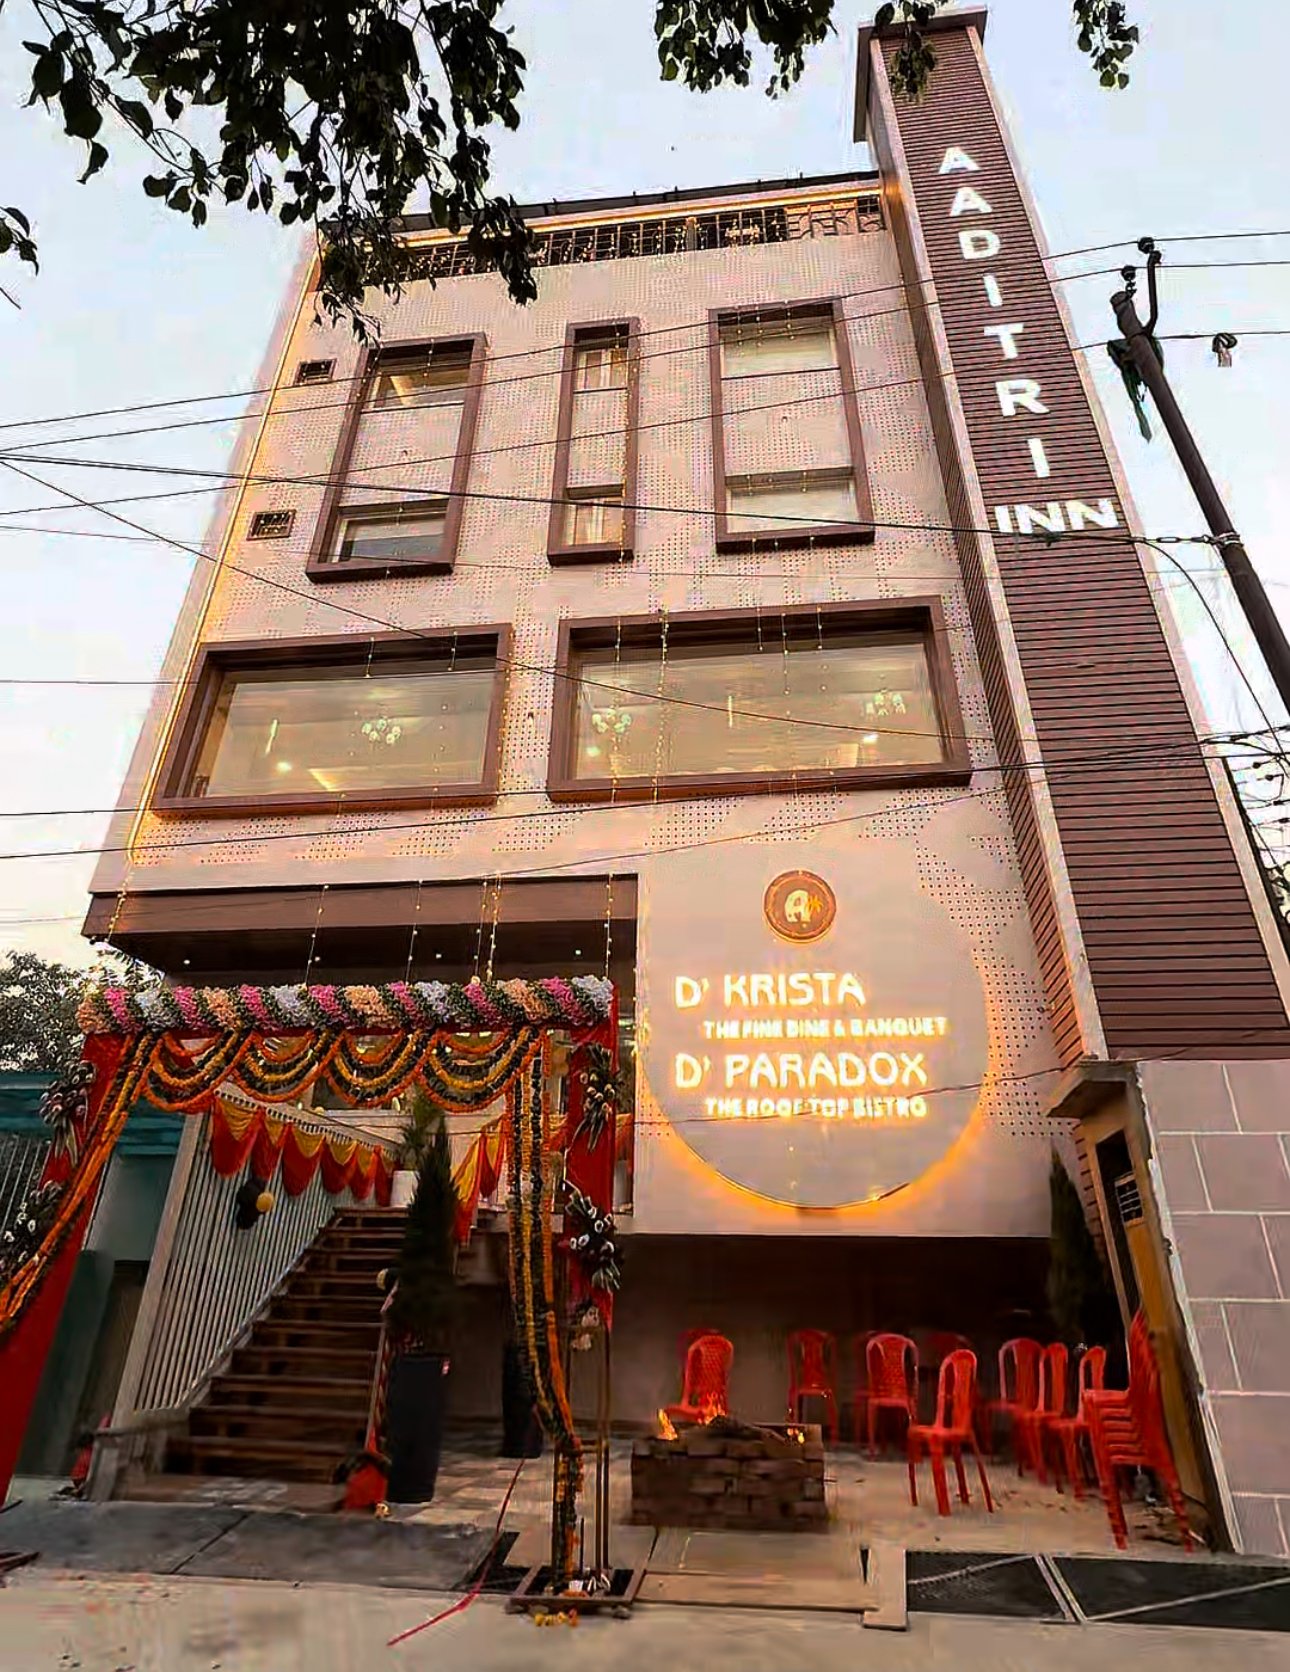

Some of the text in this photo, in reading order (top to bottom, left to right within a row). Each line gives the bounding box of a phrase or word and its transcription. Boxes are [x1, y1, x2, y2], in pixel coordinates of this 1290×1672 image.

[938, 146, 1050, 478] AADITRI
[993, 498, 1119, 534] INN
[724, 973, 867, 1006] KRISTA
[703, 1020, 740, 1039] THE
[743, 1019, 783, 1038] FINE
[786, 1018, 829, 1038] DINE
[850, 1016, 948, 1037] BANQUET
[725, 1052, 928, 1088] PARADOX
[705, 1095, 928, 1118] THE ROOF TOP BISTRO
